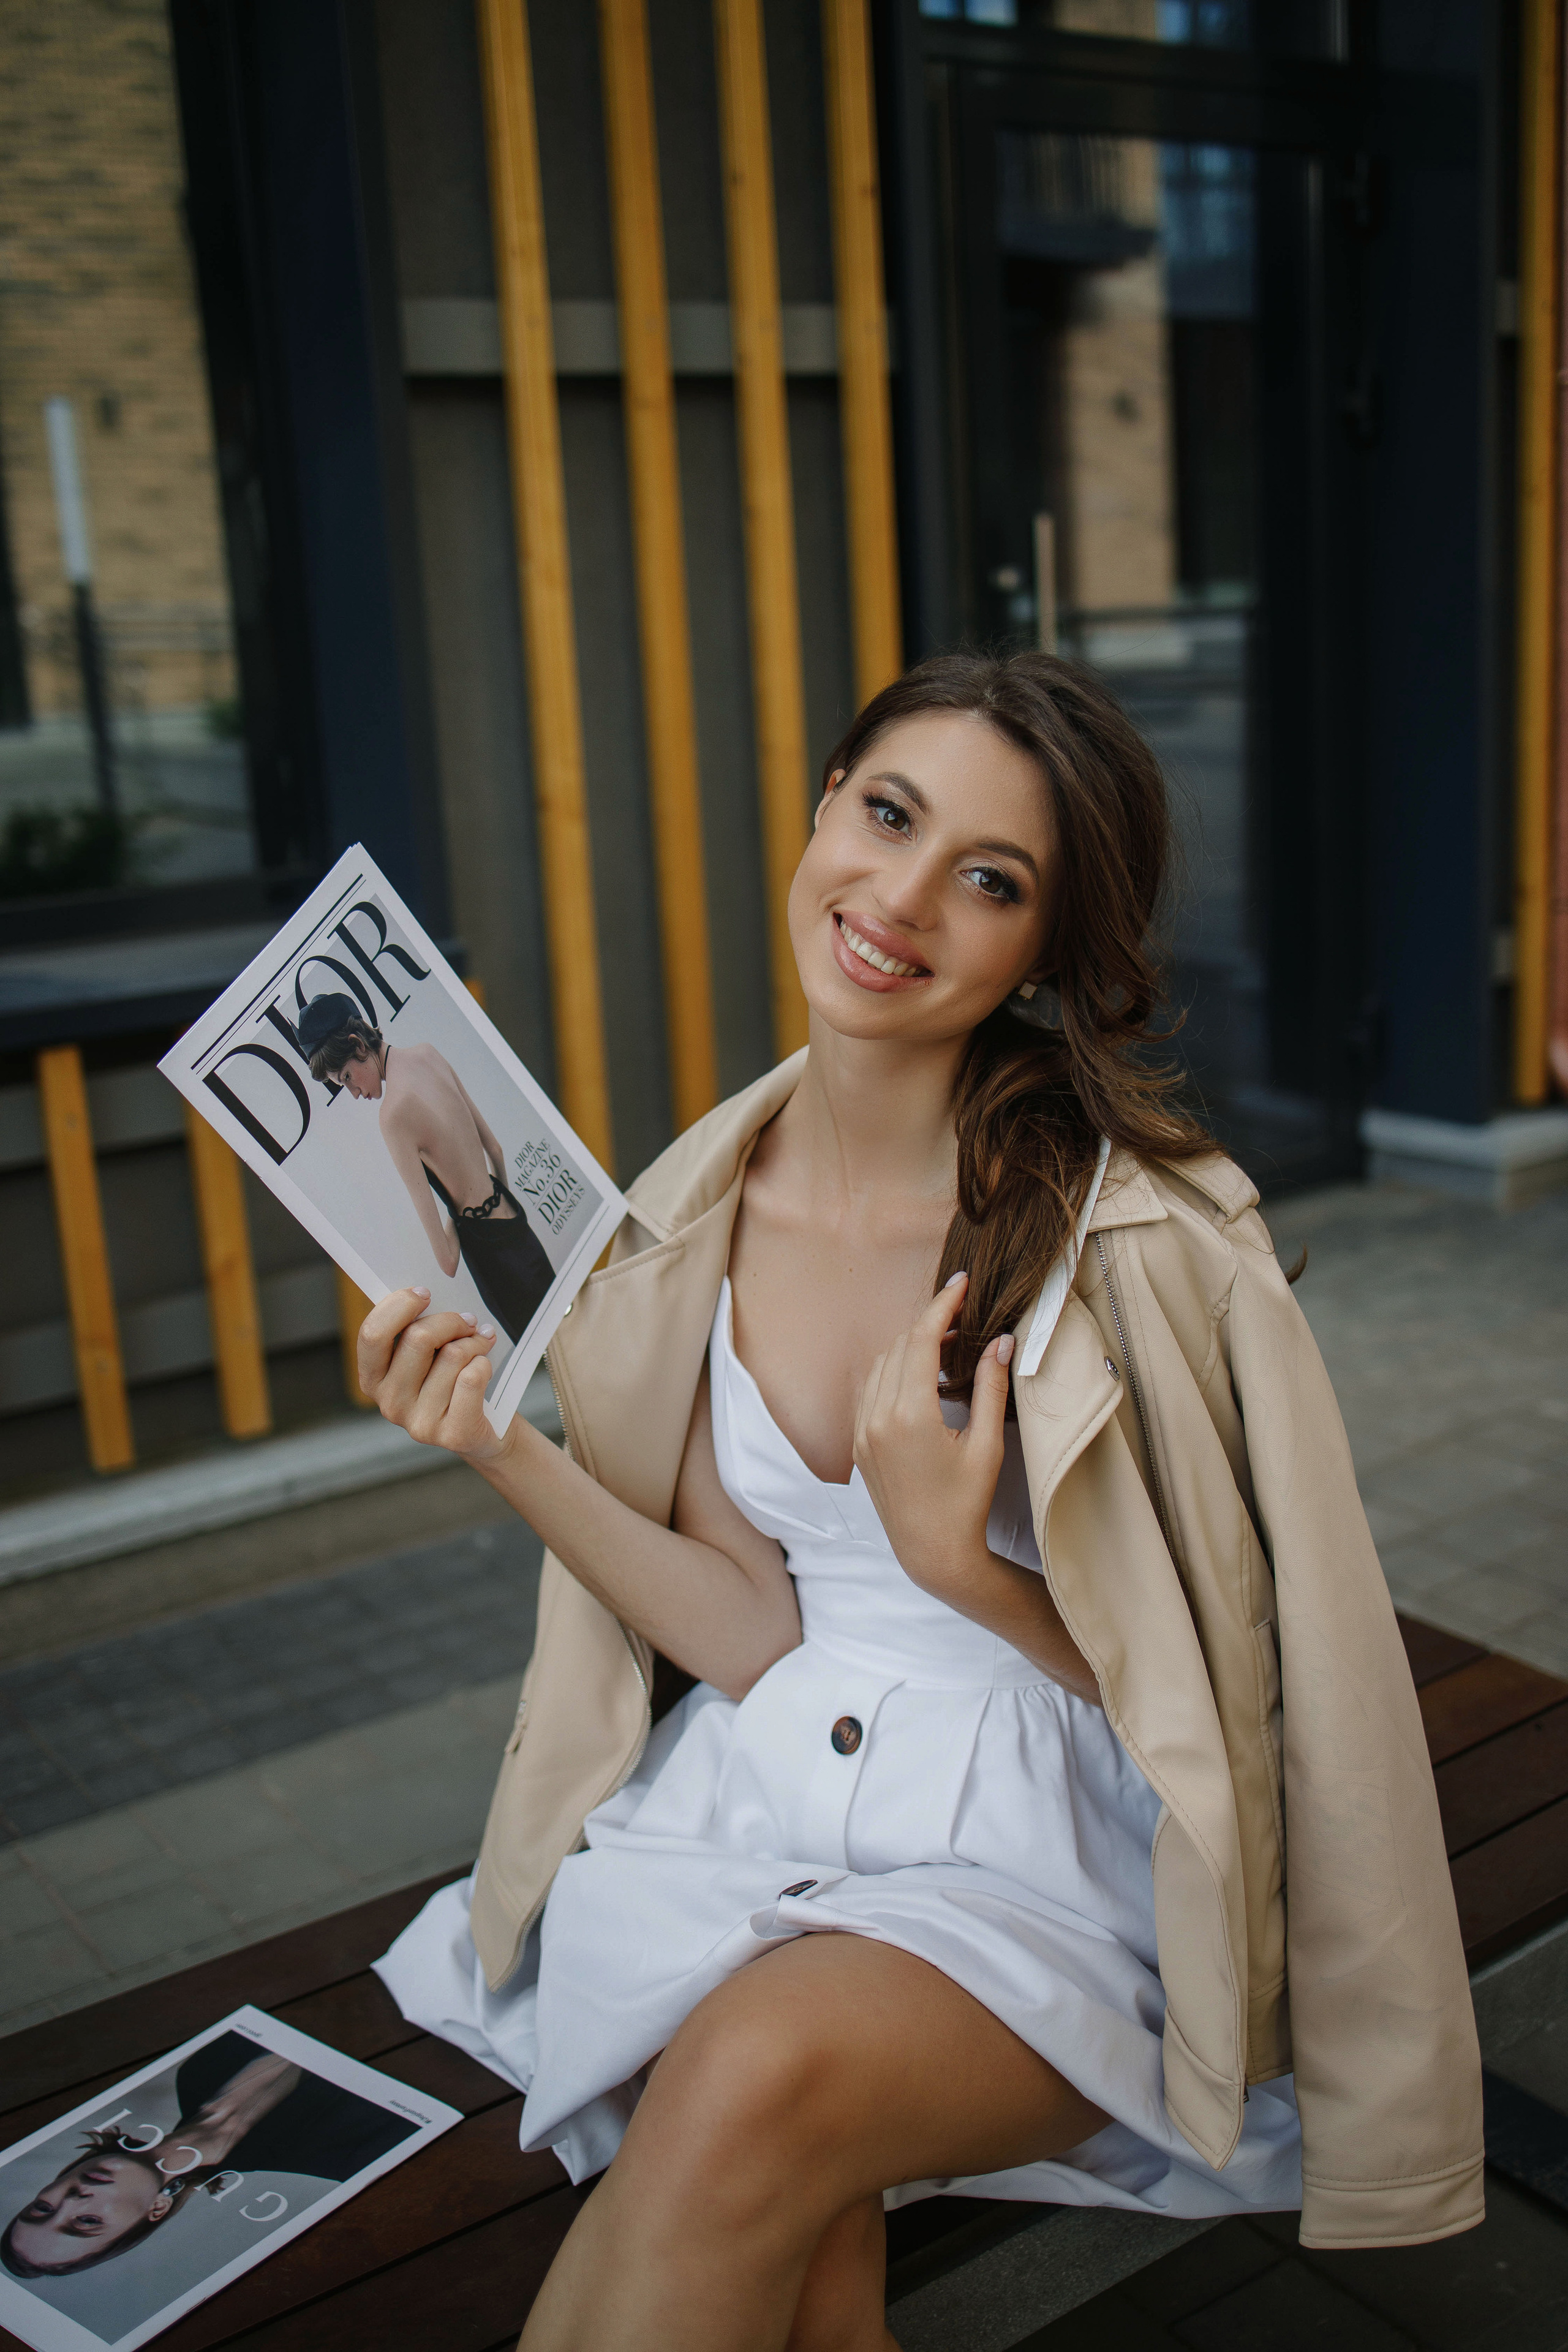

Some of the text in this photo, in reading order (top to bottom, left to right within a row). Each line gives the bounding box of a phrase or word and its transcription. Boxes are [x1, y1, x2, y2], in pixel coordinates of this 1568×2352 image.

[202, 901, 431, 1166] DIOR
[514, 1141, 534, 1169] DIOR
[514, 1139, 550, 1191] MAGAZINE
[537, 1169, 578, 1225] DIOR
[552, 1185, 585, 1235] ODYSSEYS
[93, 2108, 288, 2222] GUCCI
